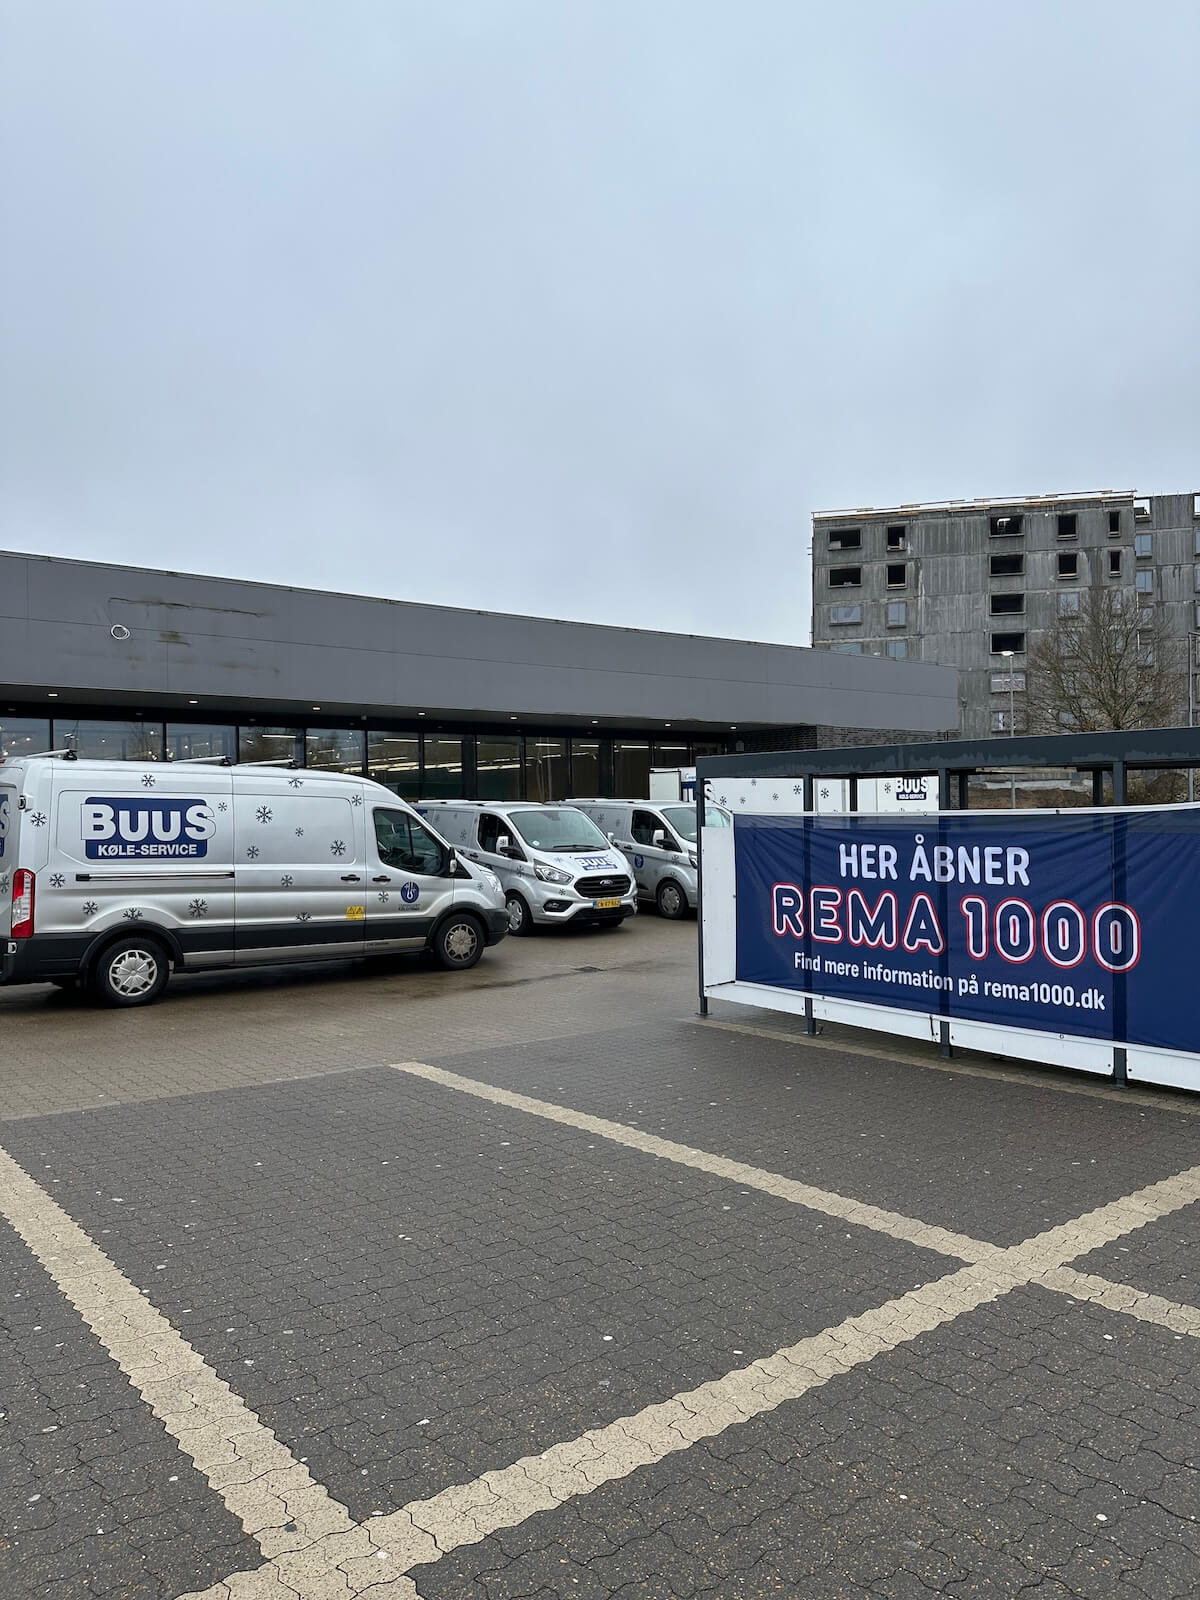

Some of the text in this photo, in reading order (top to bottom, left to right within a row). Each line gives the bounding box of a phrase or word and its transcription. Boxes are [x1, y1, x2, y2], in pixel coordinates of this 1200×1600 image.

[895, 776, 928, 793] BUUS
[80, 804, 216, 841] BUUS
[98, 844, 198, 857] KØLE-SERVICE
[839, 833, 1031, 886] HER ÅBNER
[771, 882, 1142, 974] REMA 1000
[794, 952, 1106, 1011] Find mere information på rema1000.dk
